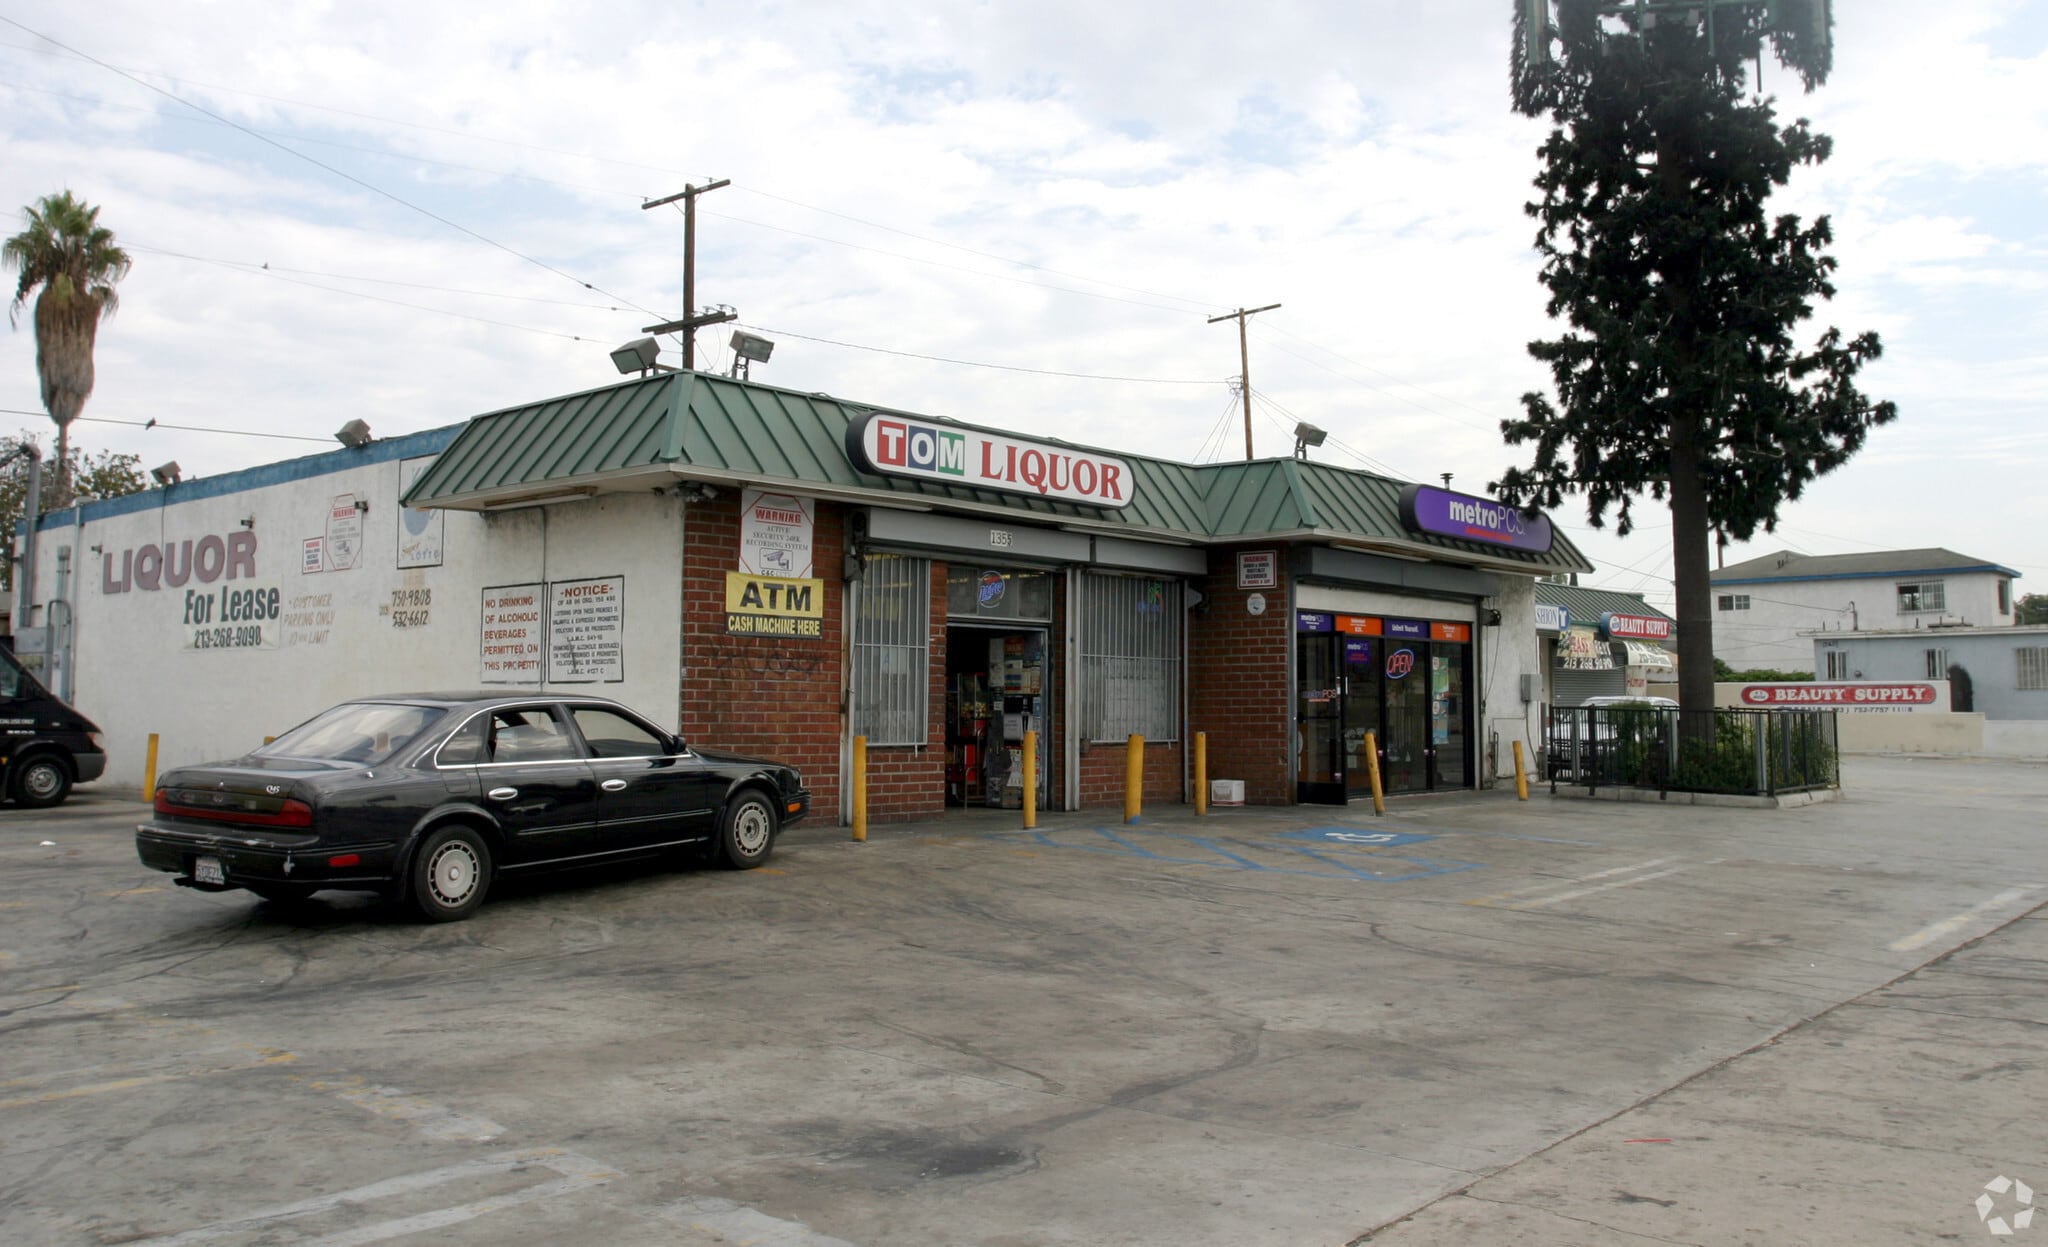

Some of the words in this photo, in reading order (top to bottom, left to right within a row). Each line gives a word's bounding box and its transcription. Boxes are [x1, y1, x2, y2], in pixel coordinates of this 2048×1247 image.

[880, 424, 965, 473] TOM
[980, 440, 1122, 500] LIQUOR
[755, 508, 801, 524] WARNING
[991, 531, 1013, 547] 1355
[102, 530, 258, 595] LIQUOR
[485, 599, 496, 609] NO
[499, 596, 534, 607] DRINKING
[739, 581, 812, 612] ATM
[183, 588, 214, 625] For
[220, 585, 280, 622] Lease
[485, 615, 495, 624] OF
[498, 612, 538, 623] ALCOHOLIC
[1534, 606, 1558, 627] SHION
[728, 615, 753, 632] CASH
[755, 617, 796, 635] MACHINE
[797, 619, 820, 636] HERE
[1620, 617, 1645, 634] BEAUTY
[1646, 620, 1668, 636] SUPPLY
[484, 628, 527, 640] BEVERAGES
[484, 644, 524, 656] PERMITTED
[527, 643, 538, 654] ON
[484, 661, 500, 671] THIS
[502, 660, 540, 671] PROPERTY
[1386, 654, 1412, 674] OPEN
[1563, 658, 1577, 669] 213
[1775, 688, 1845, 701] BEAUTY
[1854, 687, 1926, 701] SUPPLY
